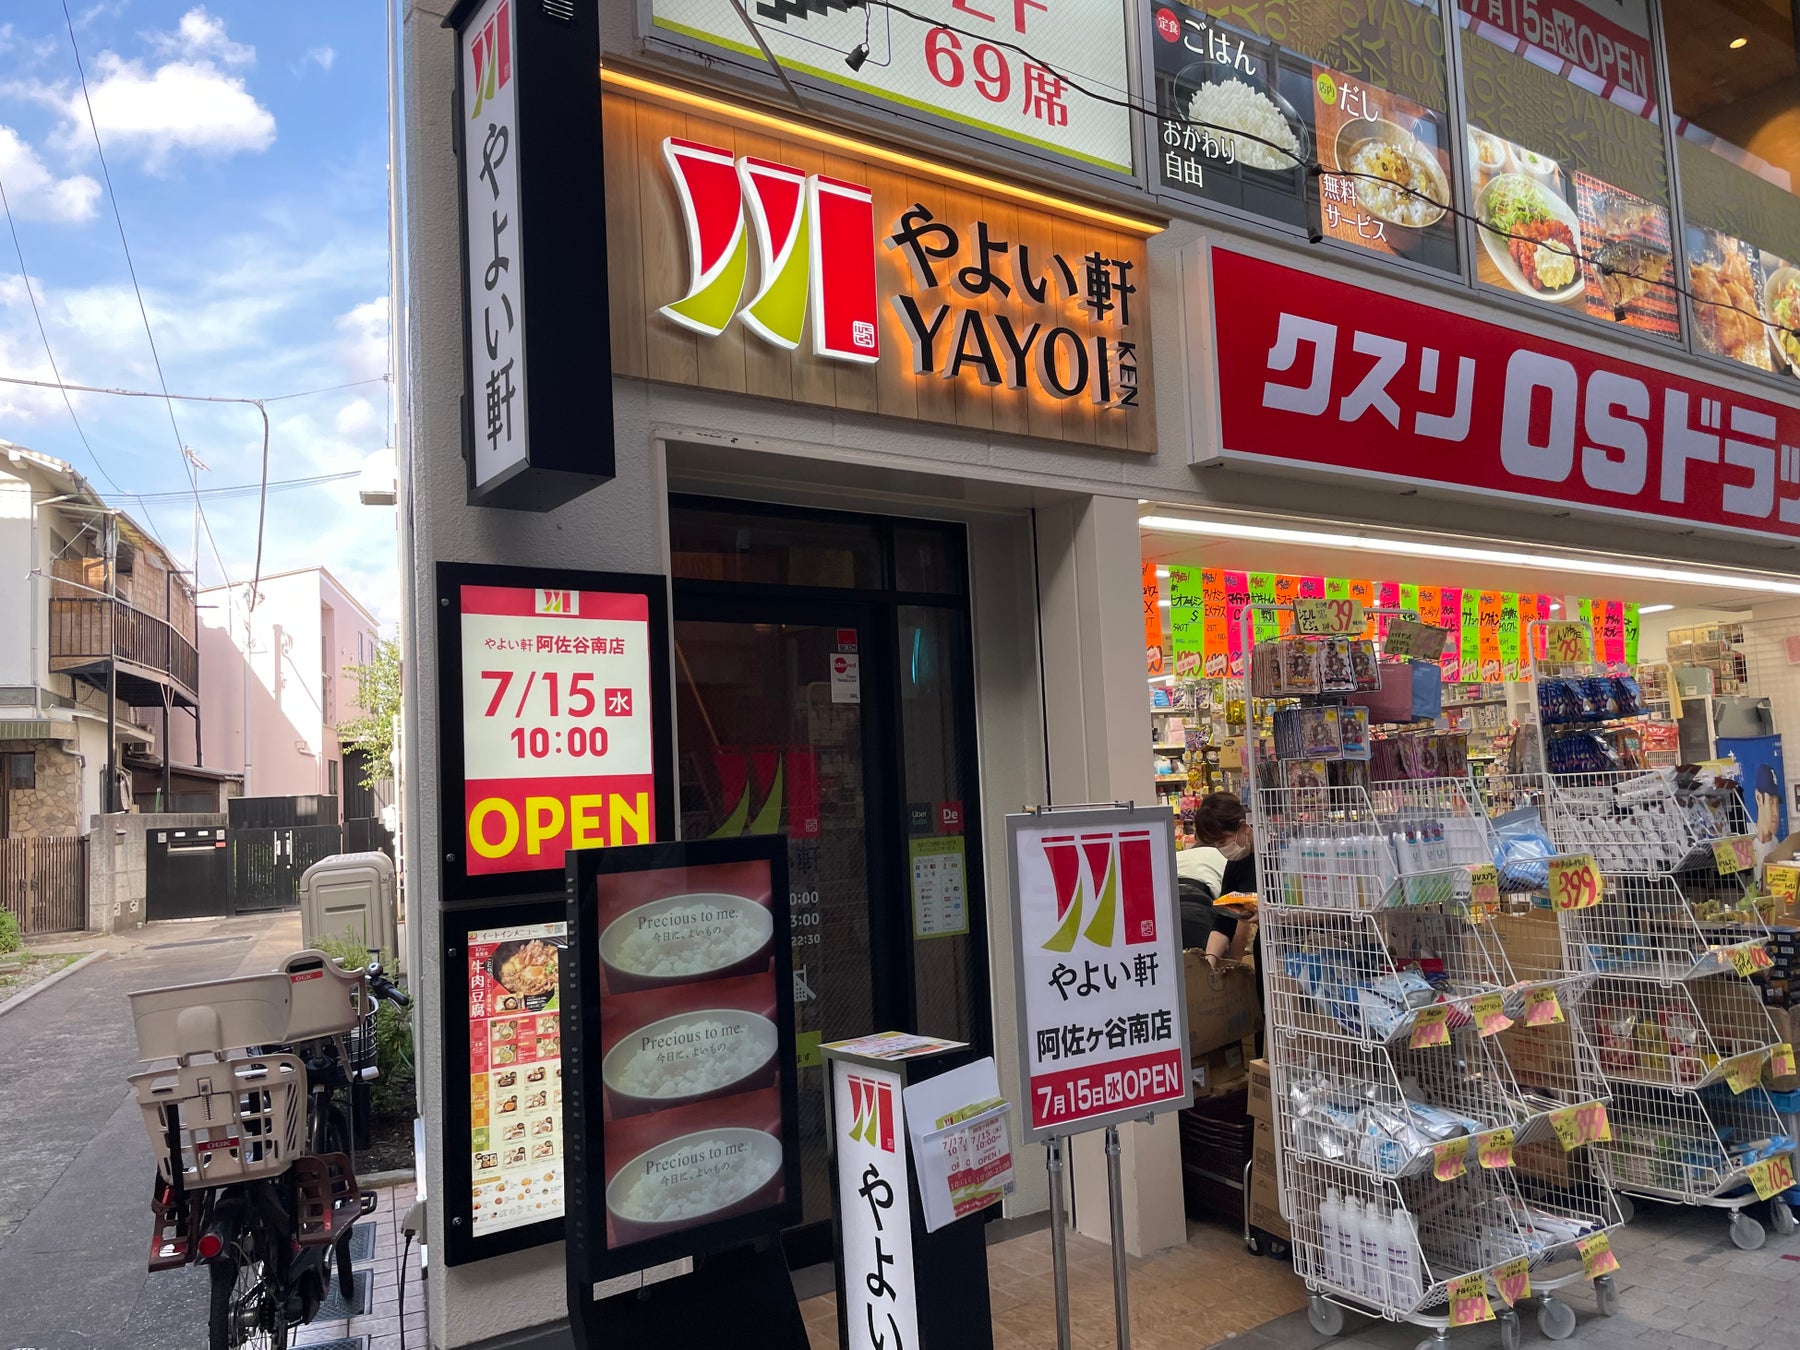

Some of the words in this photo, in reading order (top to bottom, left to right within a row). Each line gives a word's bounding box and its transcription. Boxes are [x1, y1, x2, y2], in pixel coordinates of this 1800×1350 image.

[1158, 16, 1179, 36] 定食
[1184, 19, 1257, 76] ごはん
[924, 26, 1069, 127] 69席
[1338, 82, 1379, 123] だし
[1163, 120, 1236, 165] おかわり
[1165, 151, 1204, 188] 自由
[1323, 174, 1357, 208] 無料
[1325, 204, 1388, 242] サービス
[890, 202, 1137, 328] やよい軒
[479, 122, 517, 452] やよい軒
[894, 295, 1112, 405] YAYOI
[1117, 341, 1139, 409] KEN
[1262, 311, 1477, 443] クスリ
[1327, 599, 1353, 632] 39
[484, 637, 533, 652] やよい軒
[536, 634, 625, 655] 阿佐谷南店
[1558, 638, 1578, 661] 79
[481, 671, 596, 718] 7/15
[608, 692, 630, 714] 水
[510, 726, 608, 759] 10:00
[468, 792, 649, 859] OPEN
[912, 810, 928, 818] Uber
[942, 808, 959, 820] De
[1559, 865, 1597, 909] 399
[480, 928, 540, 942] イートインメニュー
[638, 911, 697, 931] Precious
[701, 909, 714, 922] to
[717, 907, 739, 921] me.
[652, 925, 722, 944] 今日に、よいもの
[295, 974, 312, 983] OGK
[471, 959, 486, 1018] 牛肉豆腐
[1048, 951, 1159, 1002] やよい軒
[641, 1031, 702, 1052] Precious
[705, 1027, 718, 1040] to
[721, 1023, 744, 1038] me.
[656, 1041, 727, 1064] 今日に、よいもの
[206, 1139, 231, 1149] OGK
[970, 1129, 990, 1145] 7/15
[645, 1153, 707, 1176] Precious
[709, 1148, 722, 1161] to
[724, 1140, 748, 1157] me.
[660, 1161, 731, 1187] 今日に、よいもの
[1767, 1156, 1791, 1191] 105
